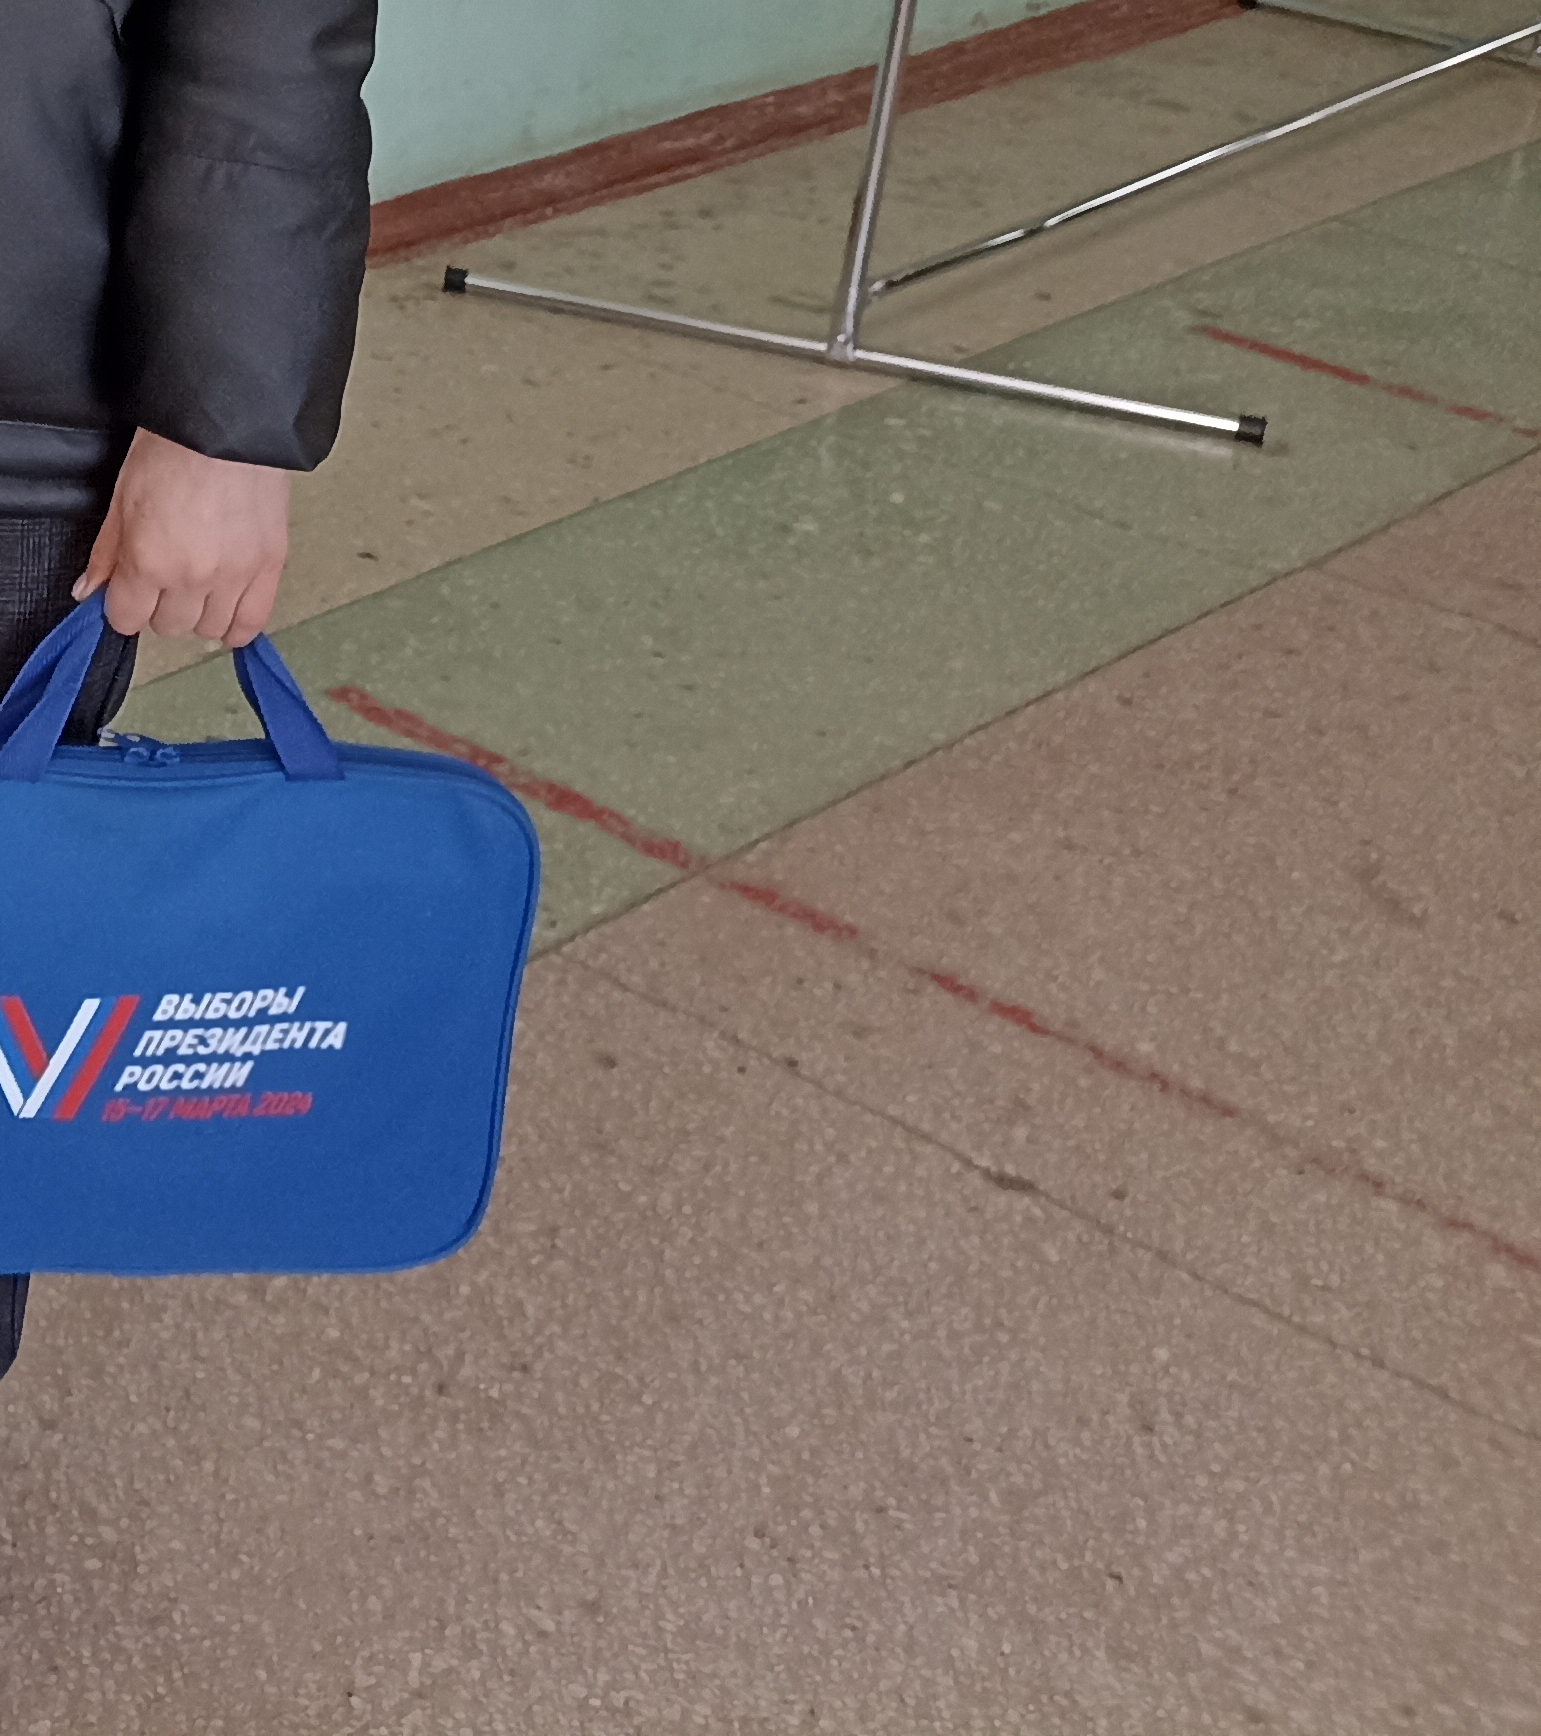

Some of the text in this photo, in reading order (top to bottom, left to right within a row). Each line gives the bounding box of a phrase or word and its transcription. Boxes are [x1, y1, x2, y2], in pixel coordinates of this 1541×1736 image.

[152, 986, 306, 1022] ВЫБОРЫ
[133, 1021, 347, 1058] ПРЕЗИДЕНТА
[114, 1060, 255, 1092] РОССИИ
